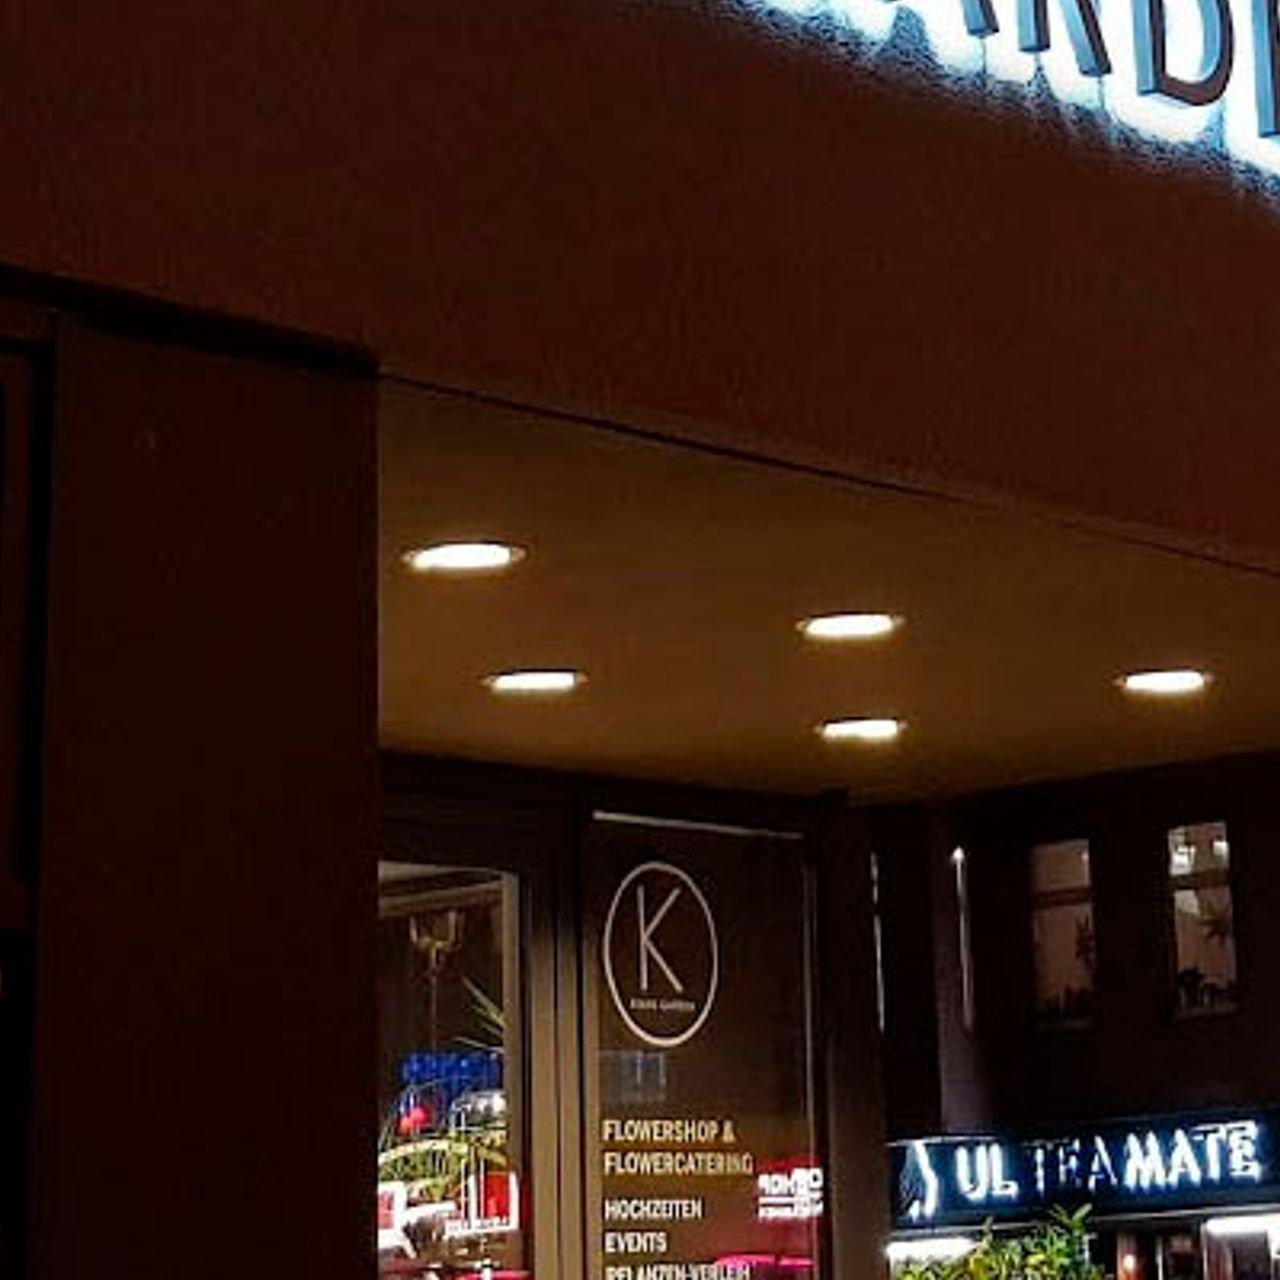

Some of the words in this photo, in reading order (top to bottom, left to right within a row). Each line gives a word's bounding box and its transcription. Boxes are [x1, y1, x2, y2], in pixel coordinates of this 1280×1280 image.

[637, 883, 684, 993] K
[602, 1119, 719, 1144] FLOWERSHOP
[722, 1120, 735, 1143] &
[603, 1151, 754, 1176] FLOWERCATERING
[604, 1197, 704, 1221] HOCHZEITEN
[604, 1231, 668, 1253] EVENTS
